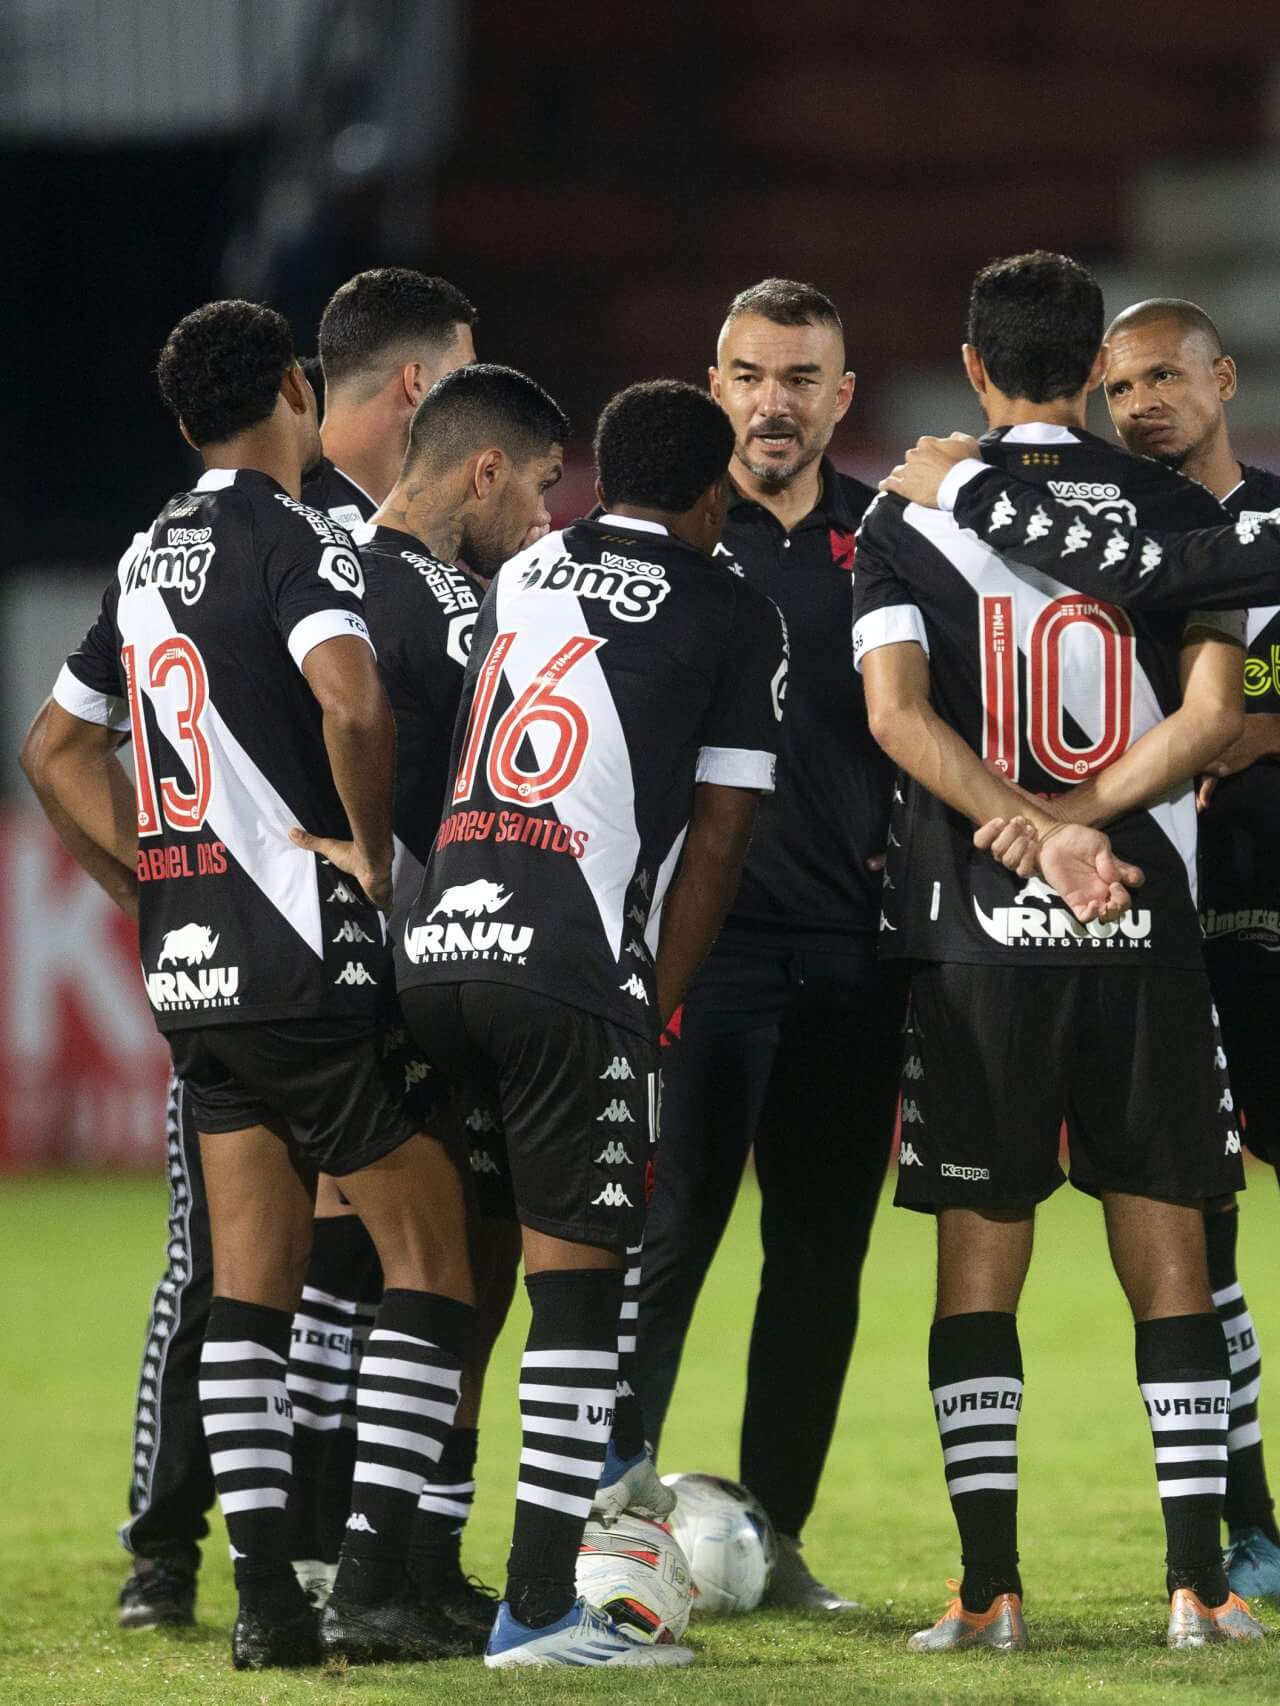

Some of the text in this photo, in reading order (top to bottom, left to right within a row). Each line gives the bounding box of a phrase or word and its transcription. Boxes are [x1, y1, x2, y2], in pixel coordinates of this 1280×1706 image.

[1047, 481, 1120, 499] VASCO
[167, 527, 212, 546] VASCO
[134, 544, 214, 605] bmg
[601, 553, 665, 579] VASCO
[542, 556, 671, 622] bmg
[1075, 604, 1100, 615] TIM
[979, 593, 1136, 784] 10
[452, 632, 608, 807] 16
[121, 633, 214, 838] 13
[1007, 937, 1151, 948] ENERGY DRINK
[472, 951, 528, 966] DRINK
[203, 996, 241, 1008] DRINK
[941, 1163, 990, 1179] Kappa
